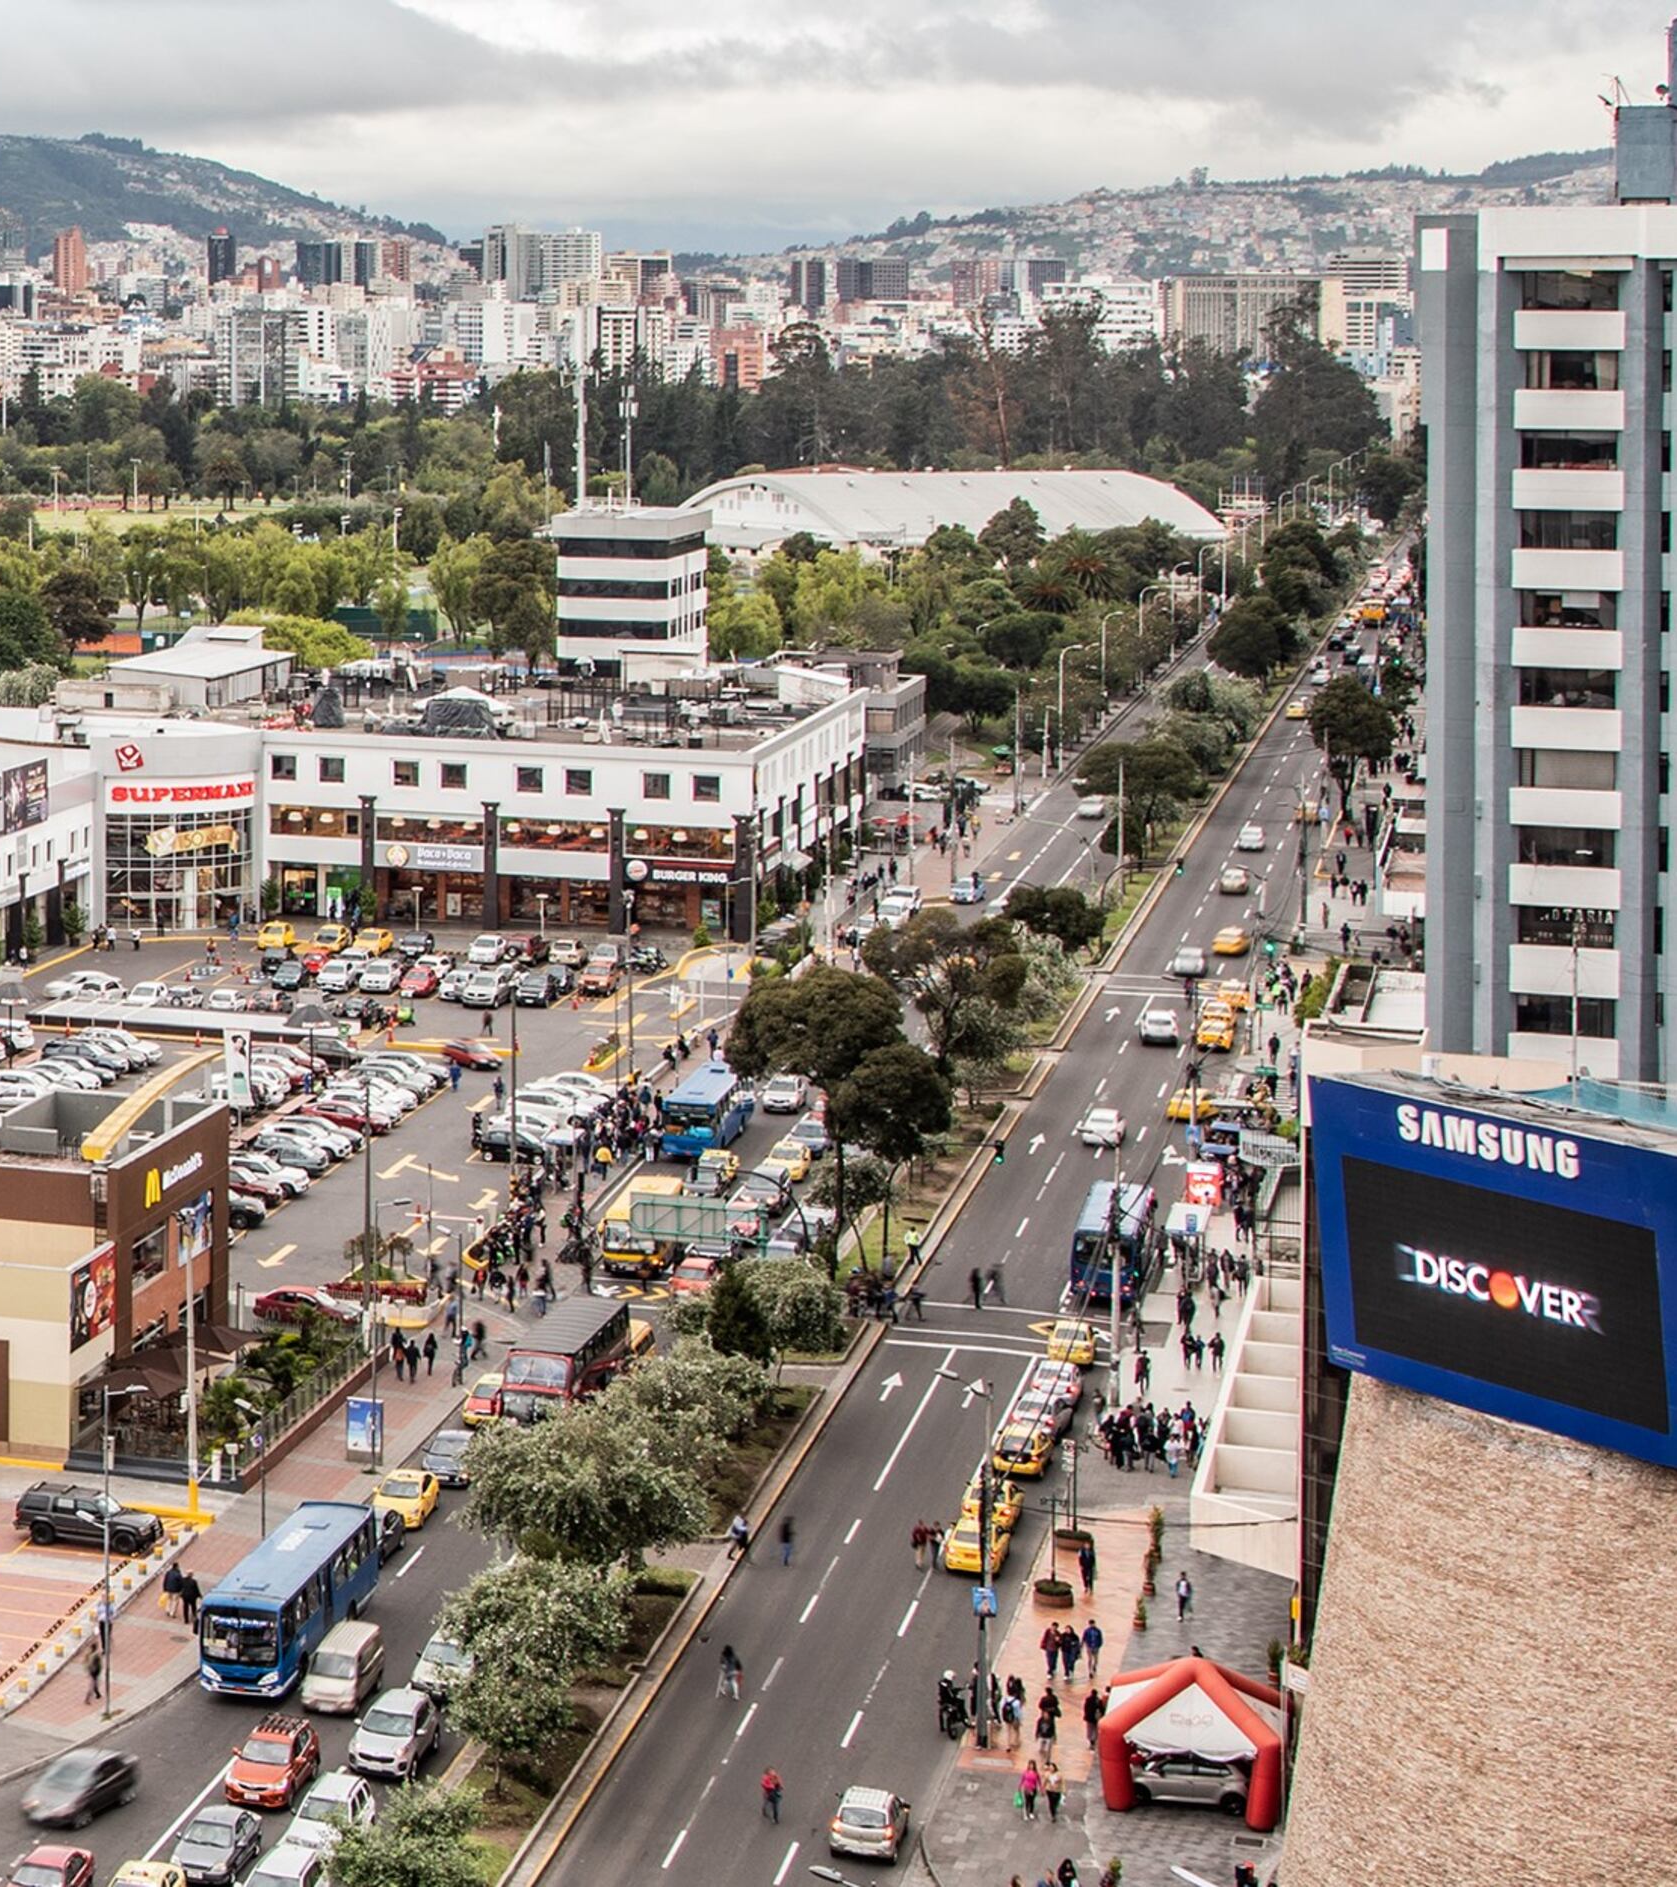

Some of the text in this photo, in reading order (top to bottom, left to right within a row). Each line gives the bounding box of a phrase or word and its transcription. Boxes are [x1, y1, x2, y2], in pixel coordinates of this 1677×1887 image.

[652, 868, 728, 884] BURGER KING
[1397, 1104, 1580, 1180] SAMSUNG
[1412, 1250, 1586, 1328] DISCOVER
